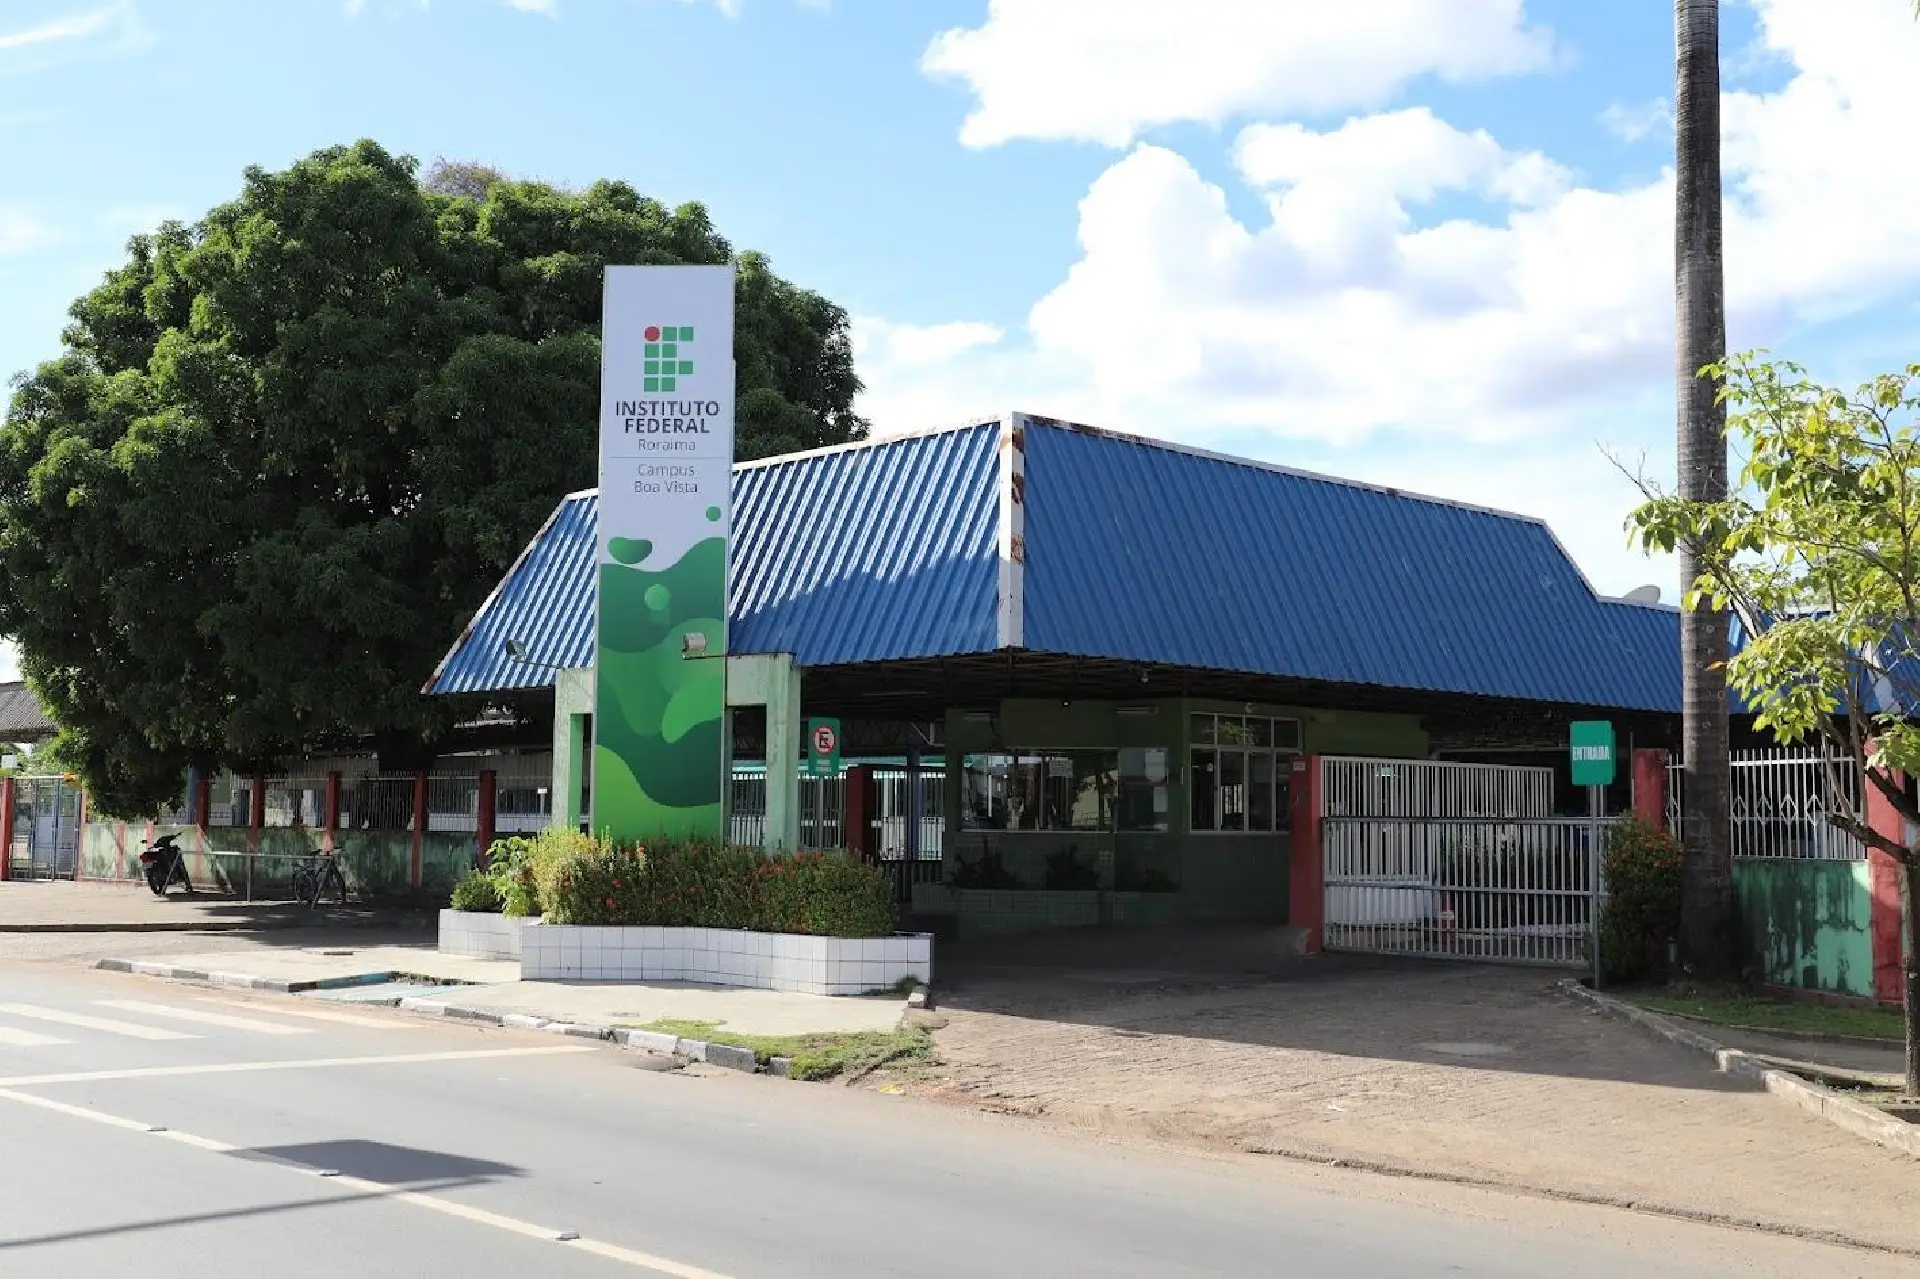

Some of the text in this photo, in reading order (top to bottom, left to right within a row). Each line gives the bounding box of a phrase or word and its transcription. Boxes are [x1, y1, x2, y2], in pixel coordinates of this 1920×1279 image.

[616, 401, 720, 416] INSTITUTO
[625, 418, 710, 433] FEDERAL
[638, 439, 696, 451] Roraima
[638, 464, 695, 478] Campus
[634, 481, 698, 493] Boa Vista
[1572, 746, 1610, 761] ENTRADA
